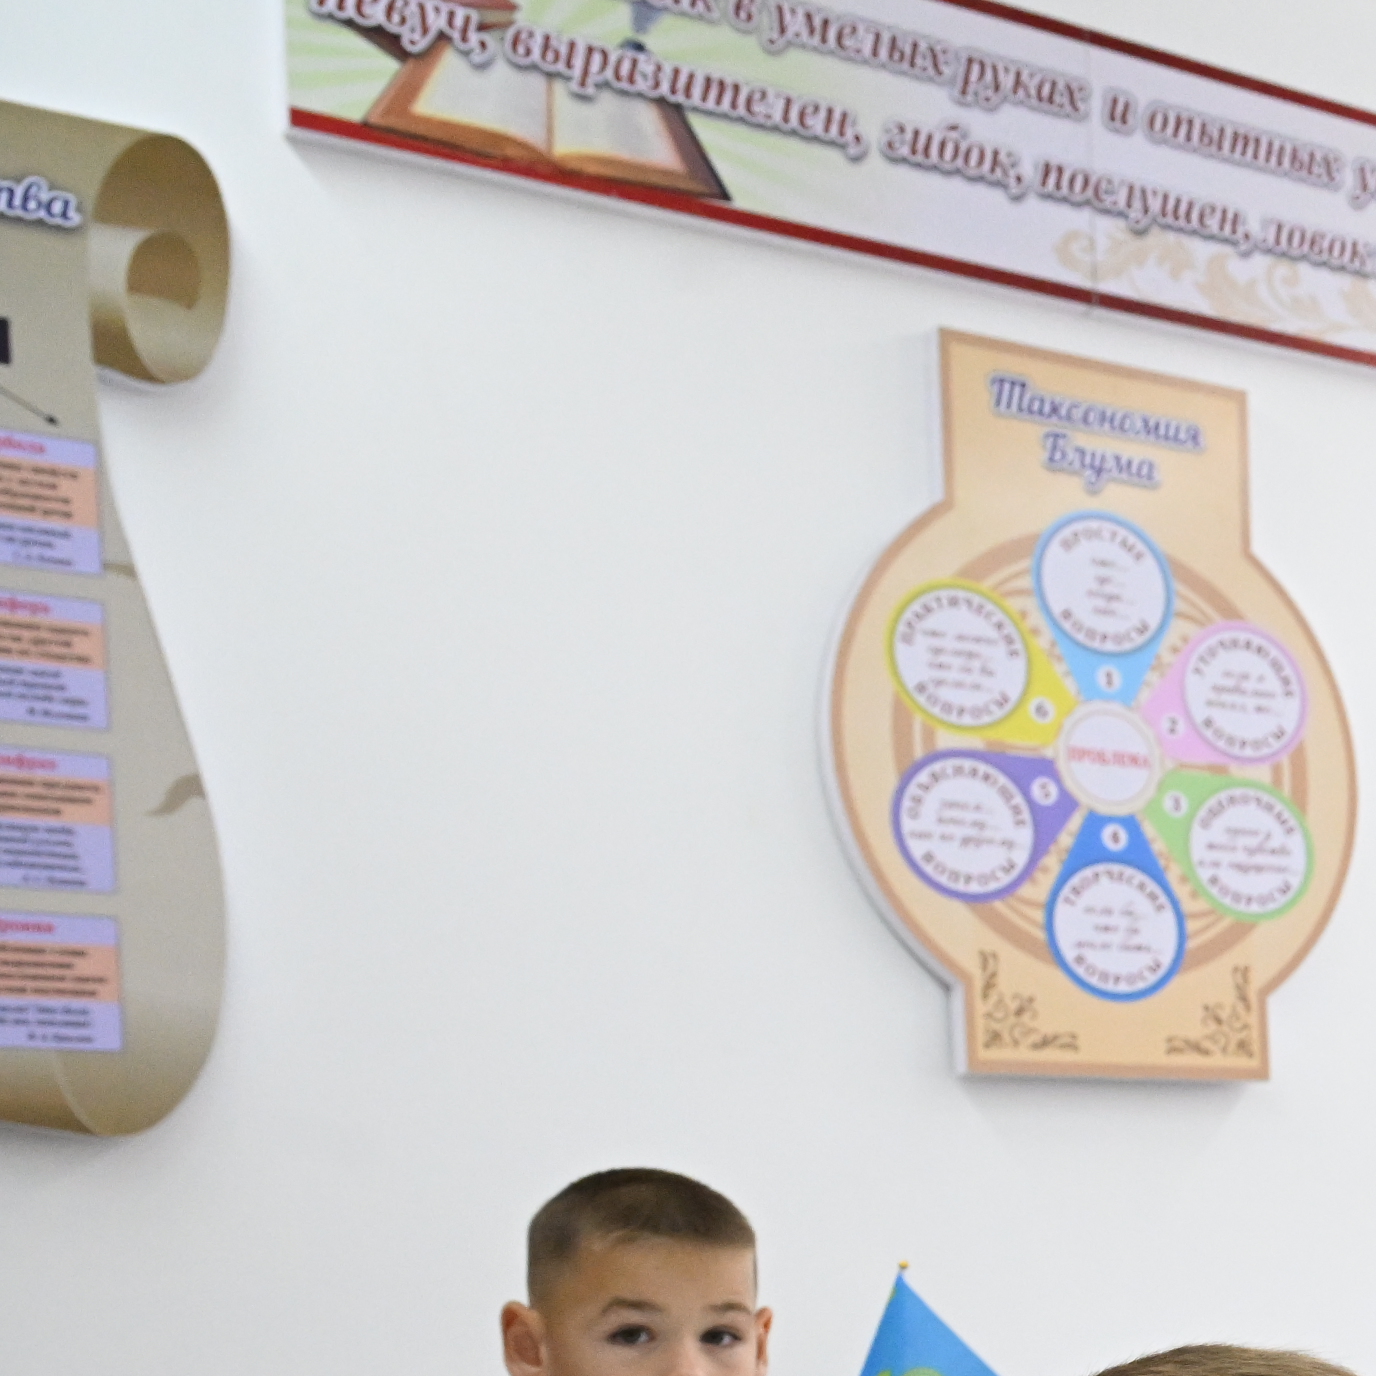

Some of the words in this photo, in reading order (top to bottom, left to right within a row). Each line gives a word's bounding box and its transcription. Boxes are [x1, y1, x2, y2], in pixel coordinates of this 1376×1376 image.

[317, 0, 487, 52] евуч,
[511, 27, 862, 146] выразителен,
[887, 122, 1022, 187] гибок,
[1040, 161, 1251, 243] послушен,
[1263, 219, 1367, 266] ловок
[767, 3, 946, 76] умелых
[960, 55, 1087, 113] руках
[1108, 95, 1131, 126] и
[1148, 110, 1341, 184] опытных
[990, 377, 1204, 448] Таксономия
[1043, 431, 1156, 485] Блума
